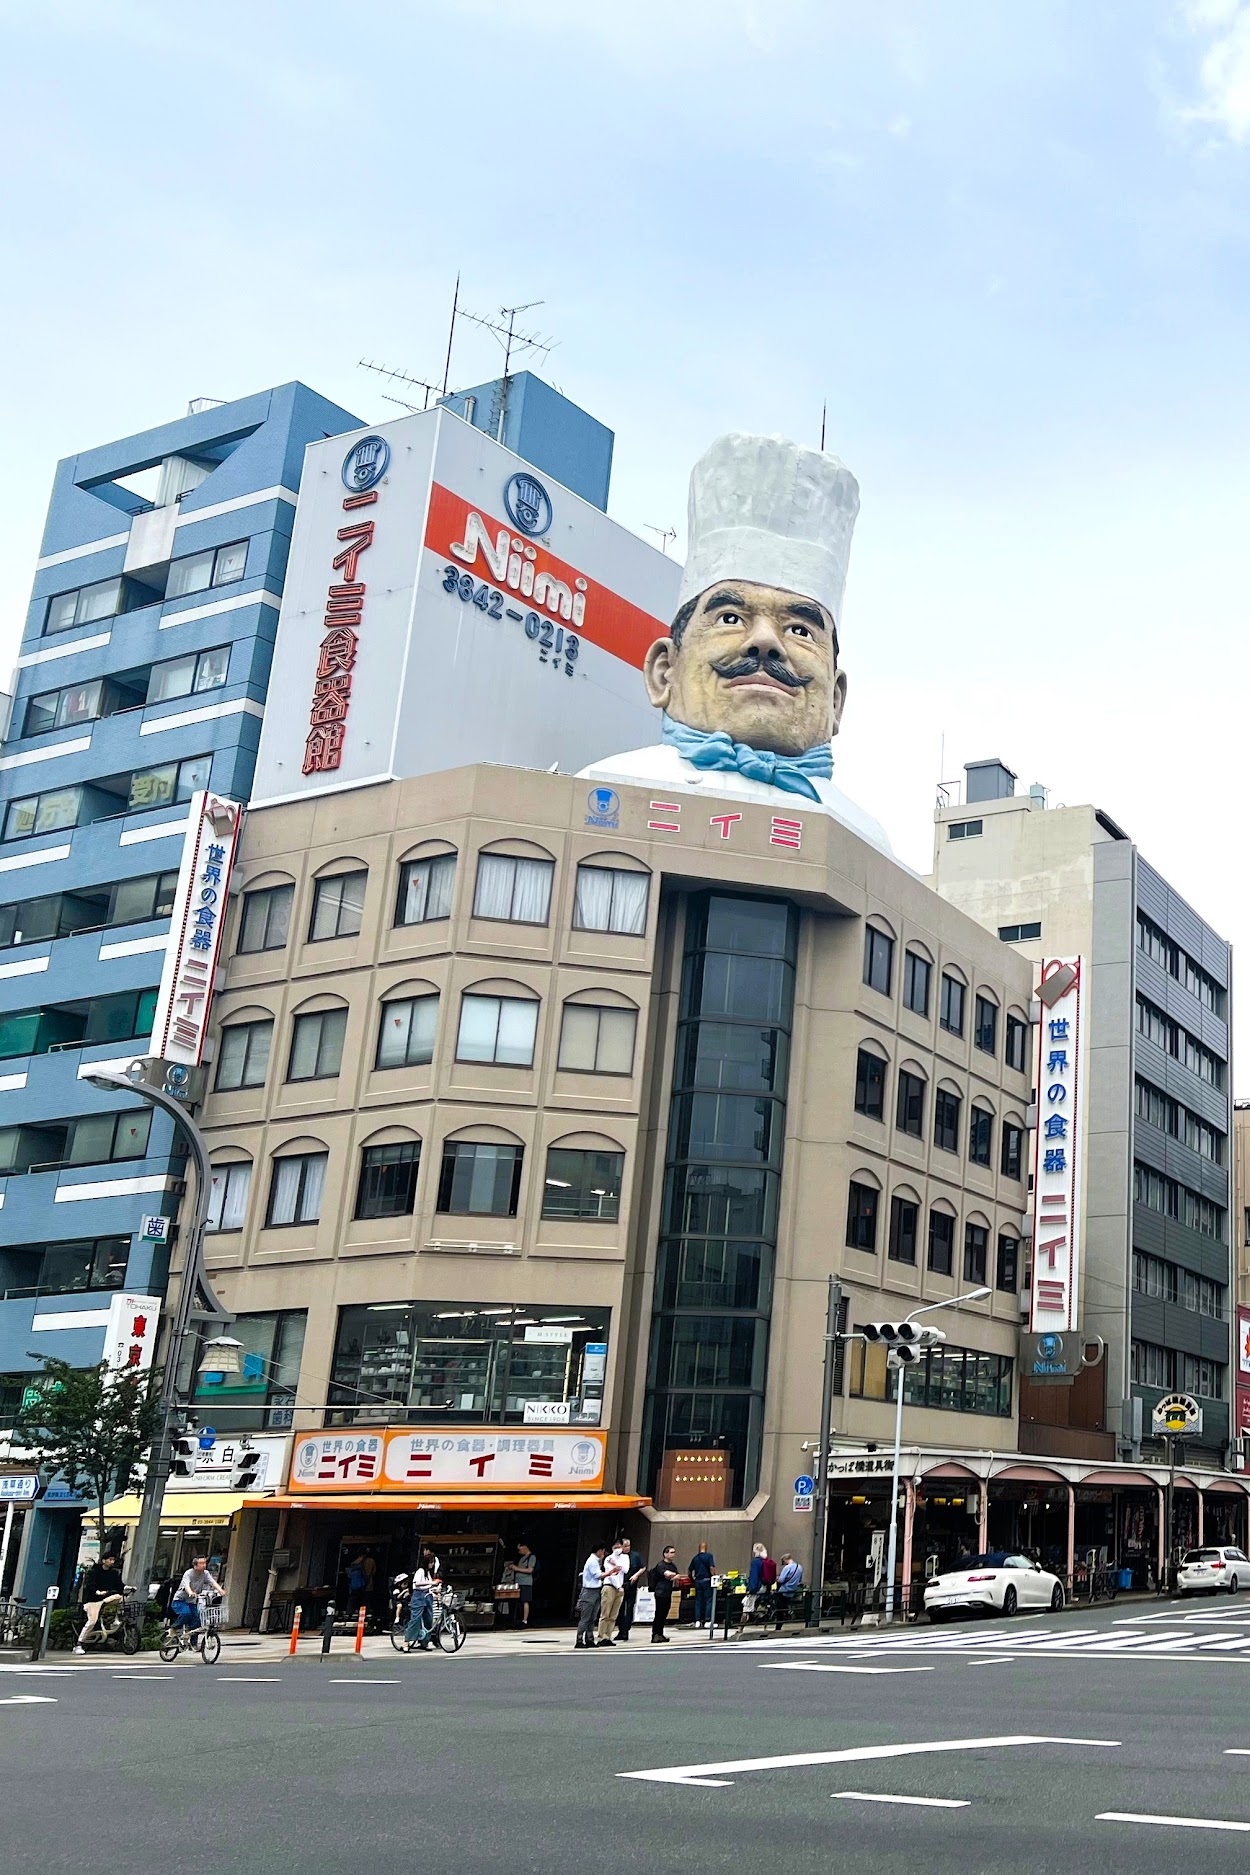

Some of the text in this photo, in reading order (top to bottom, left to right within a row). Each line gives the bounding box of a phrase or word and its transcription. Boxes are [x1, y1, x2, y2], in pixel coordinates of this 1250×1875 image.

[449, 511, 588, 628] Niimi
[302, 490, 378, 776] ニイミ食器館
[441, 565, 580, 661] 3842-0213
[647, 800, 802, 850] ニイミ
[191, 842, 225, 951] 世界の食器
[169, 958, 208, 1050] ニイミ
[1042, 1017, 1070, 1173] 世界の食器
[147, 1218, 166, 1237] 歯
[1036, 1194, 1067, 1313] ニイミ
[527, 1405, 567, 1415] NIKKO
[318, 1454, 376, 1479] ニイミ
[322, 1439, 378, 1454] 世界の食器
[406, 1453, 554, 1478] ニイミ
[410, 1438, 555, 1453] 世界の食器・調理器具
[568, 1466, 594, 1475] Niimi
